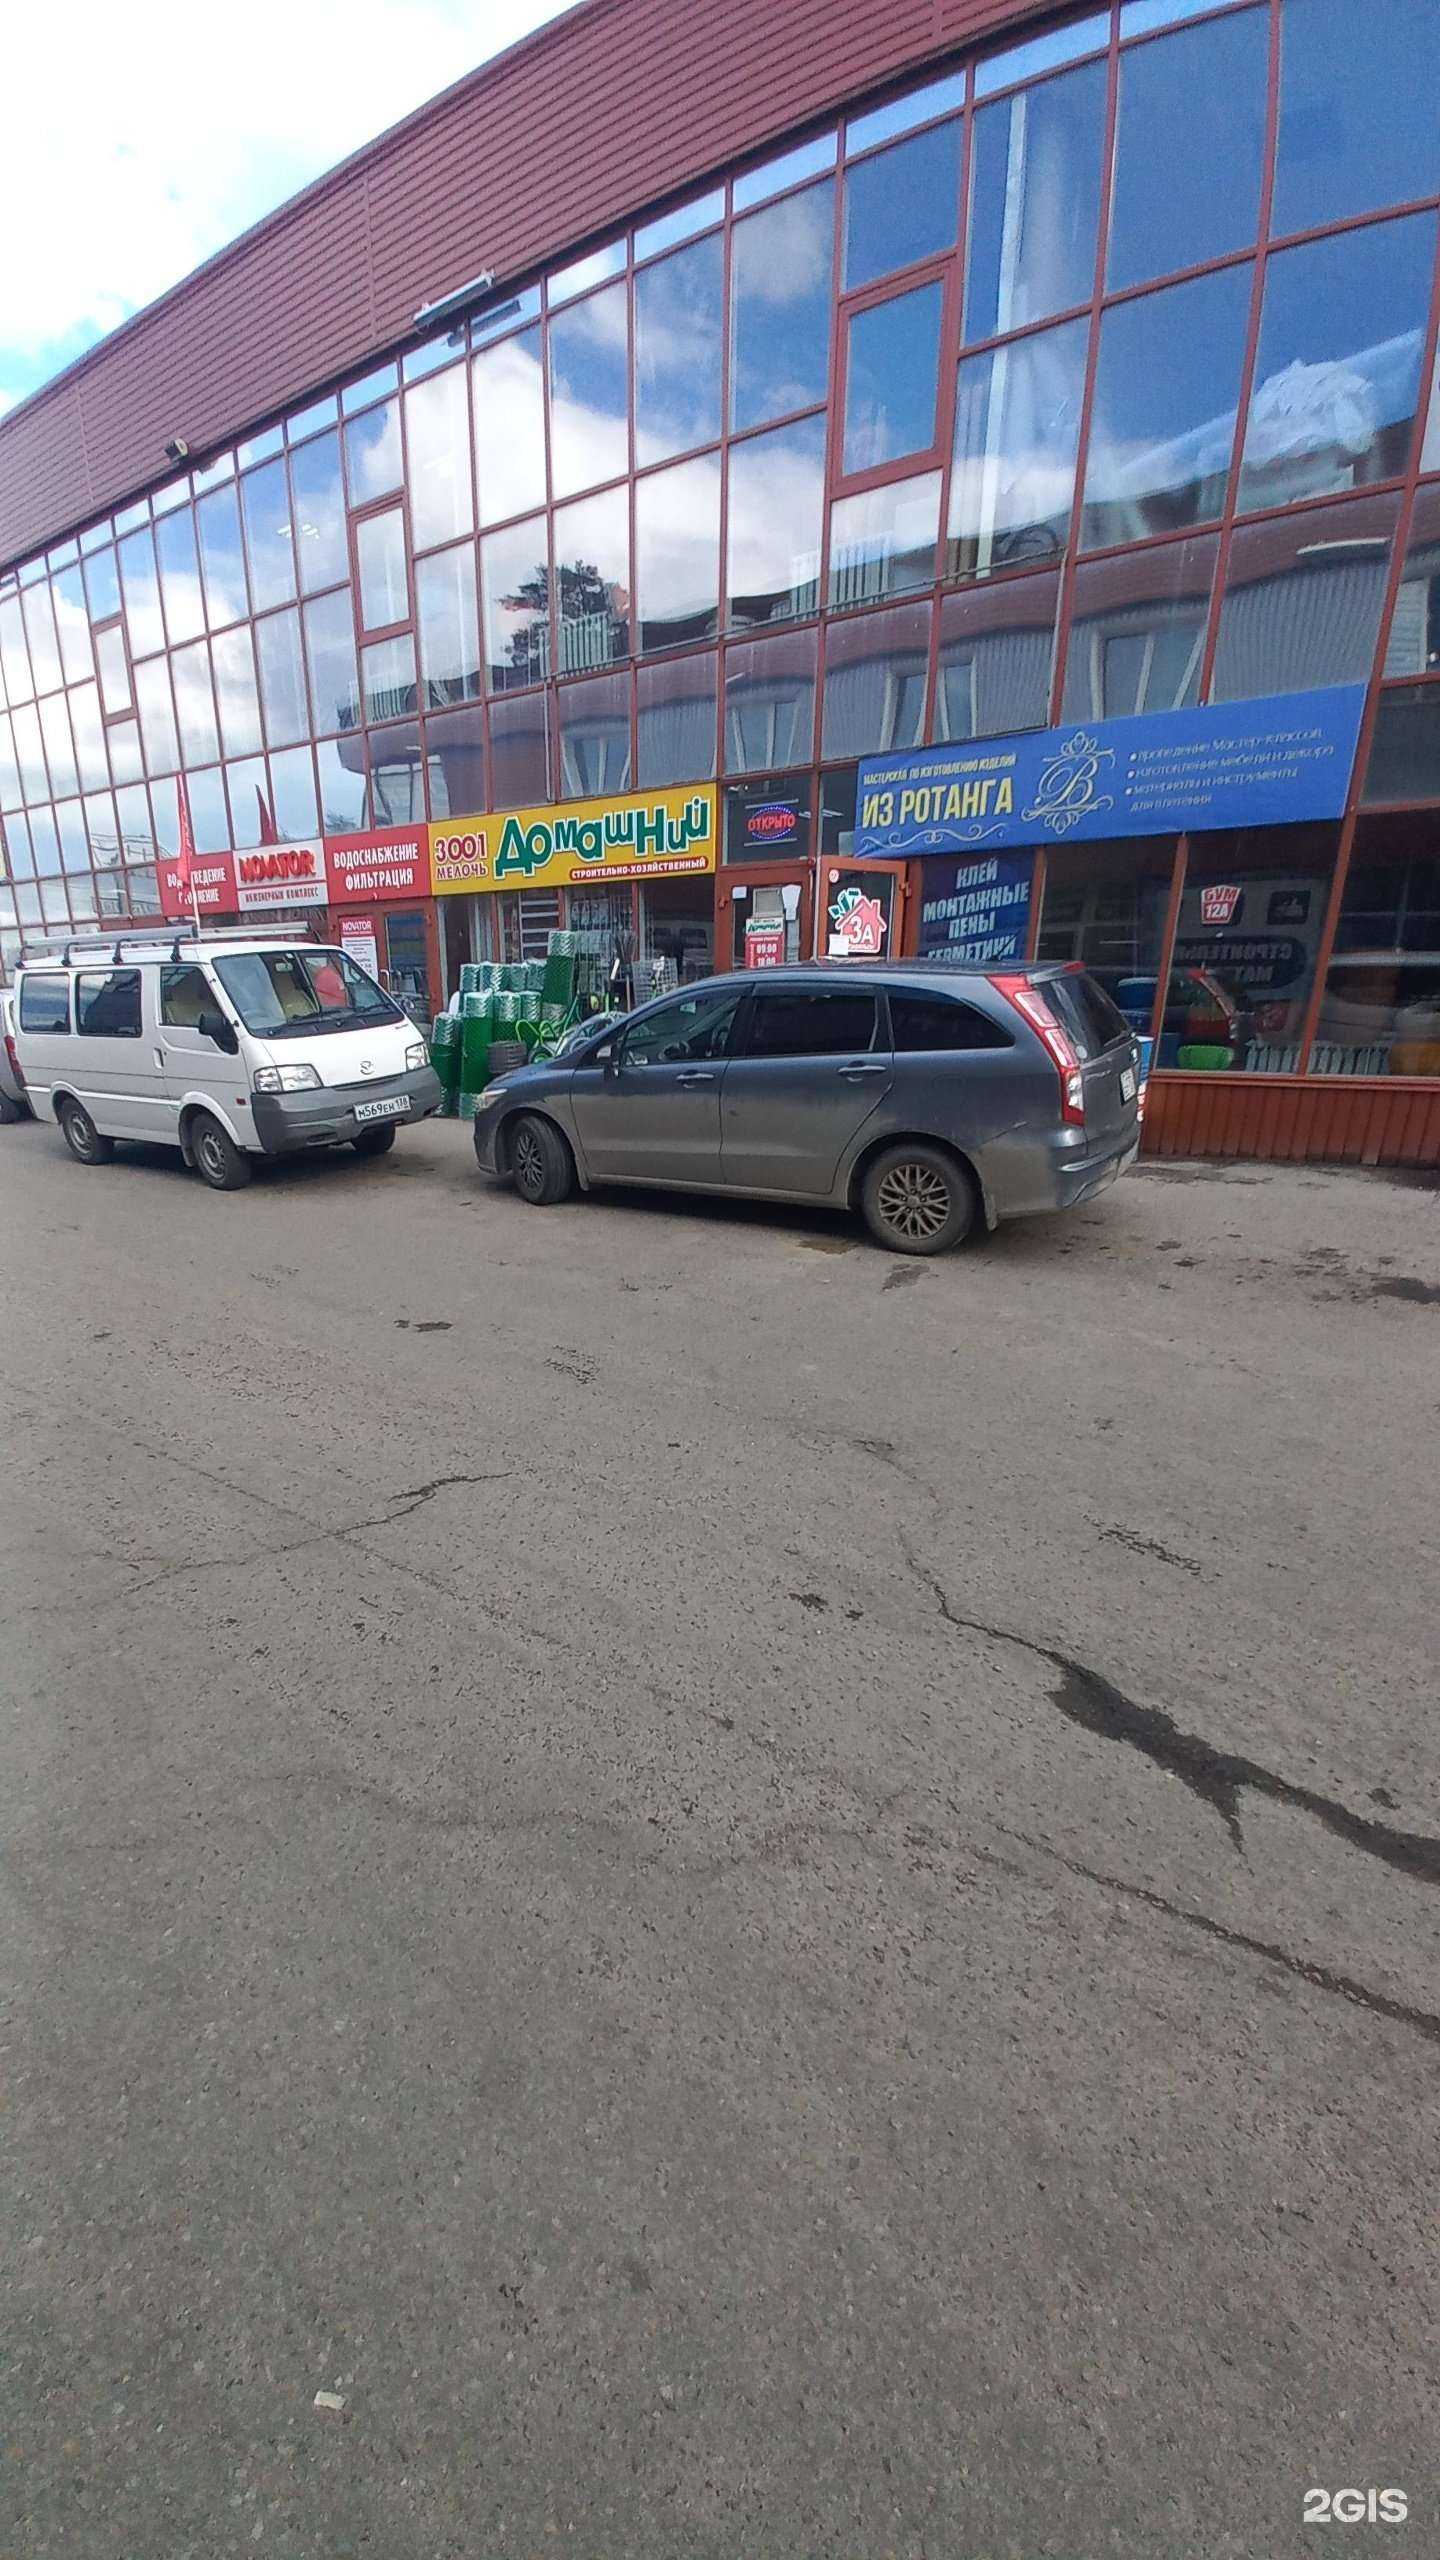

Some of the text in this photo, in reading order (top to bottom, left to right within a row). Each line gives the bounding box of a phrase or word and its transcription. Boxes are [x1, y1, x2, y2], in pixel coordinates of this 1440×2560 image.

[862, 776, 1014, 829] ИЗ РОТАНГА
[747, 814, 796, 832] ОТКРЫТО
[333, 842, 419, 870] ВОДОСНАБЖЕНИЕ
[435, 831, 488, 864] 3001
[239, 849, 316, 883] NOVATOR
[345, 867, 414, 891] ФИЛЬТРАЦИЯ
[436, 861, 489, 880] МЕЛОЧЬ
[571, 858, 707, 879] СТРОИТЕЛЬНО-ХОЗЯЙСТВЕННЫЙ
[955, 857, 998, 889] КЛЕЙ
[923, 881, 1030, 923] МОНТАЖНЫЕ
[342, 920, 372, 931] NOVATOR
[948, 911, 996, 940] ПЕНЫ
